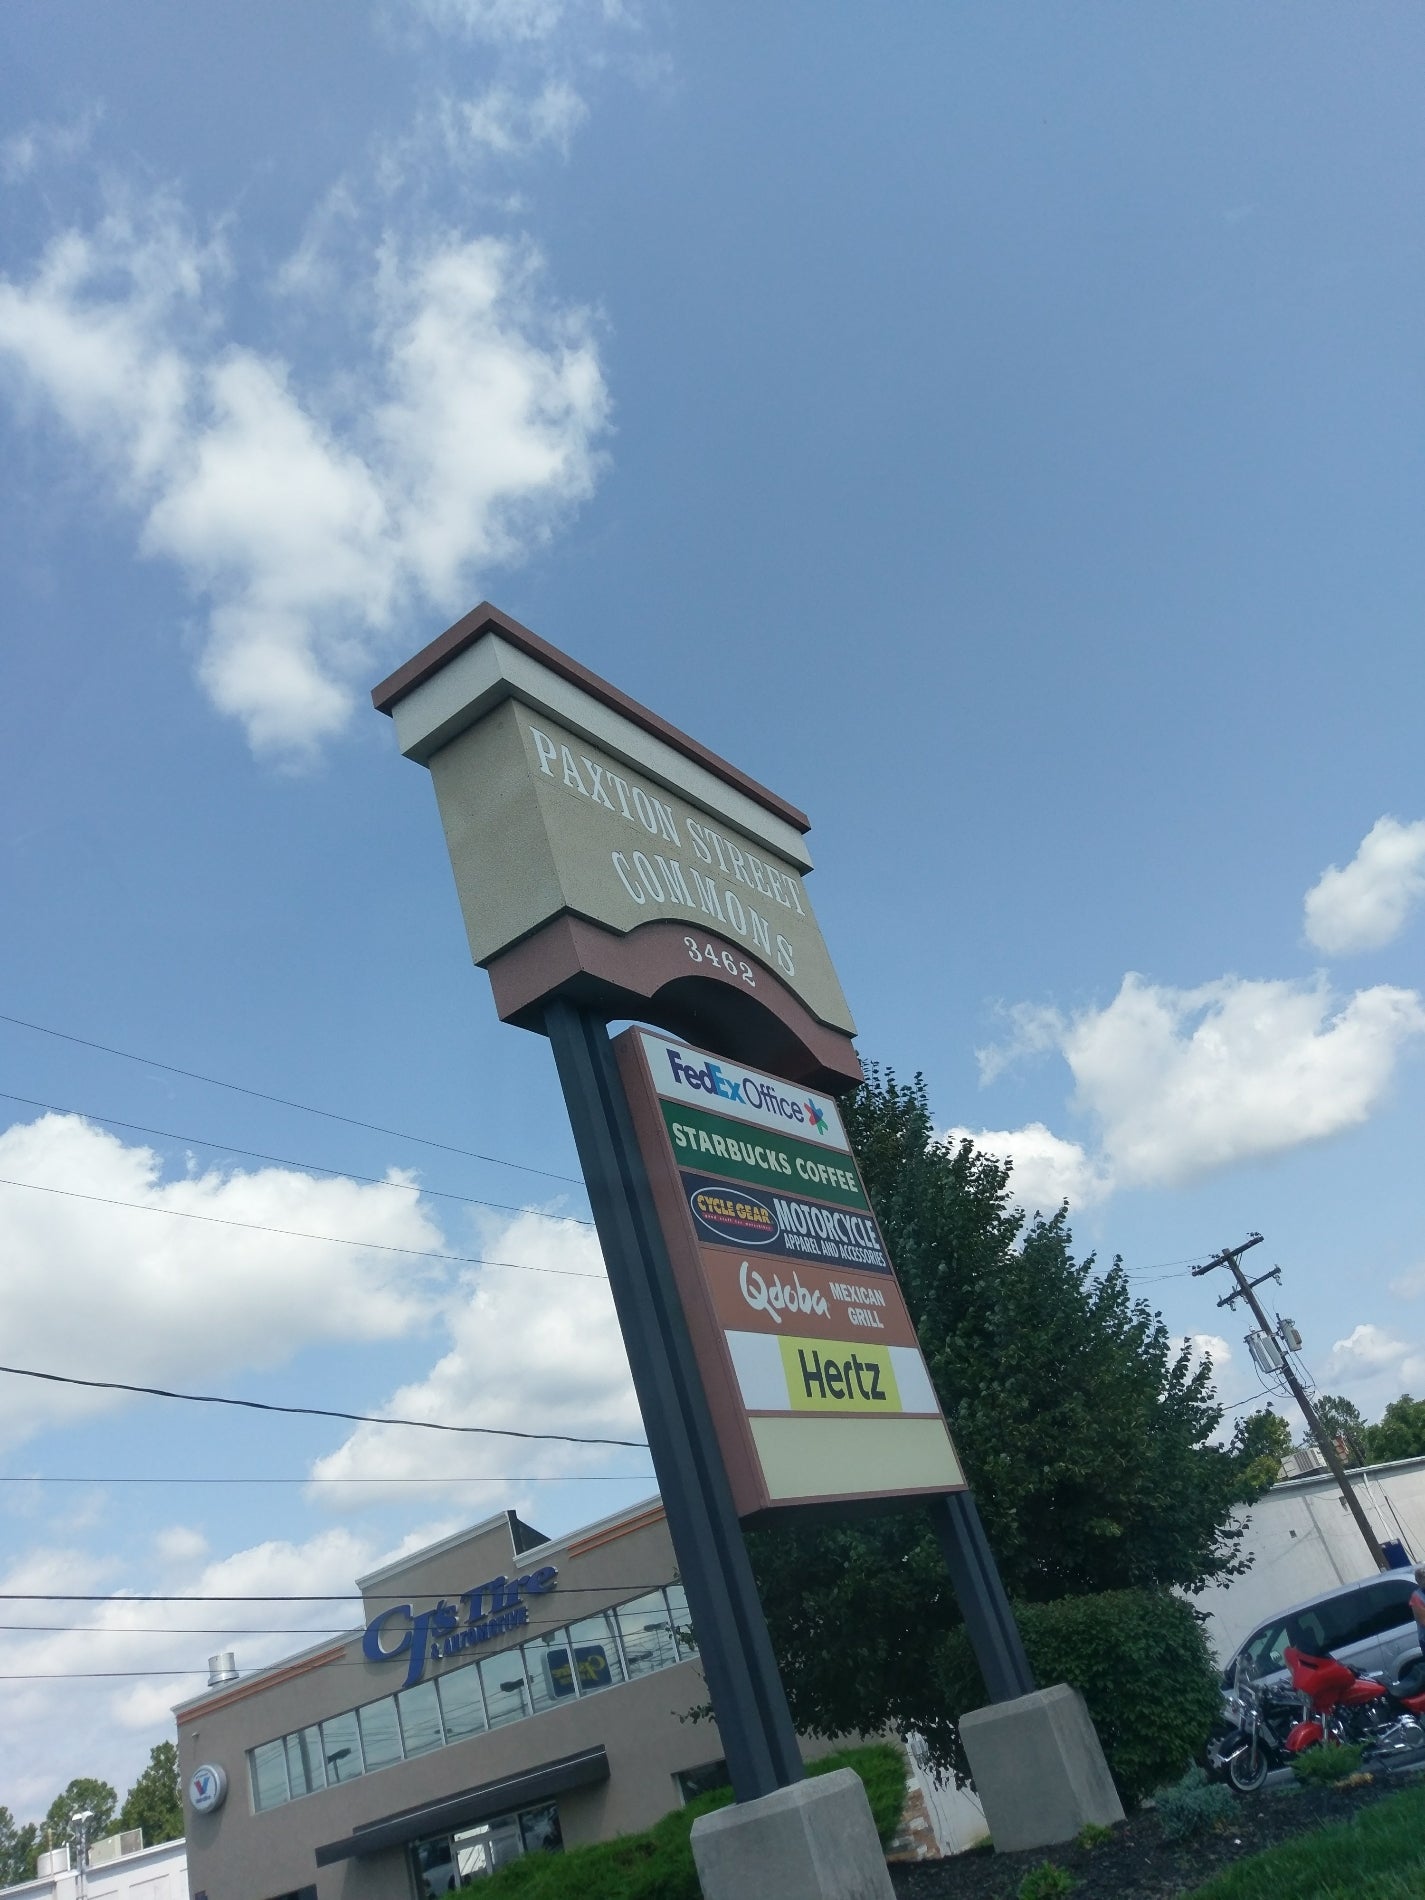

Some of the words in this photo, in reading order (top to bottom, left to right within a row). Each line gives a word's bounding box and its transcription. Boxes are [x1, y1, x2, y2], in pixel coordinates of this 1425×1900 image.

[529, 725, 681, 847] PAXTON
[686, 817, 805, 916] STREET
[611, 850, 795, 977] COMMONS
[684, 936, 756, 987] 3462
[672, 1122, 792, 1175] STARBUCKS
[796, 1158, 859, 1193] COFFEE
[697, 1194, 735, 1217] CYCLE
[735, 1203, 771, 1224] GEAR
[773, 1198, 880, 1249] MOTORCYCLE
[784, 1233, 822, 1255] APPAREL
[821, 1240, 839, 1258] AND
[839, 1244, 887, 1267] ACCESSORIES
[739, 1261, 831, 1323] Qdoba
[829, 1282, 886, 1307] MEXICAN
[848, 1307, 884, 1328] GRILL
[797, 1349, 886, 1401] Hertz
[460, 1566, 559, 1624] Tire
